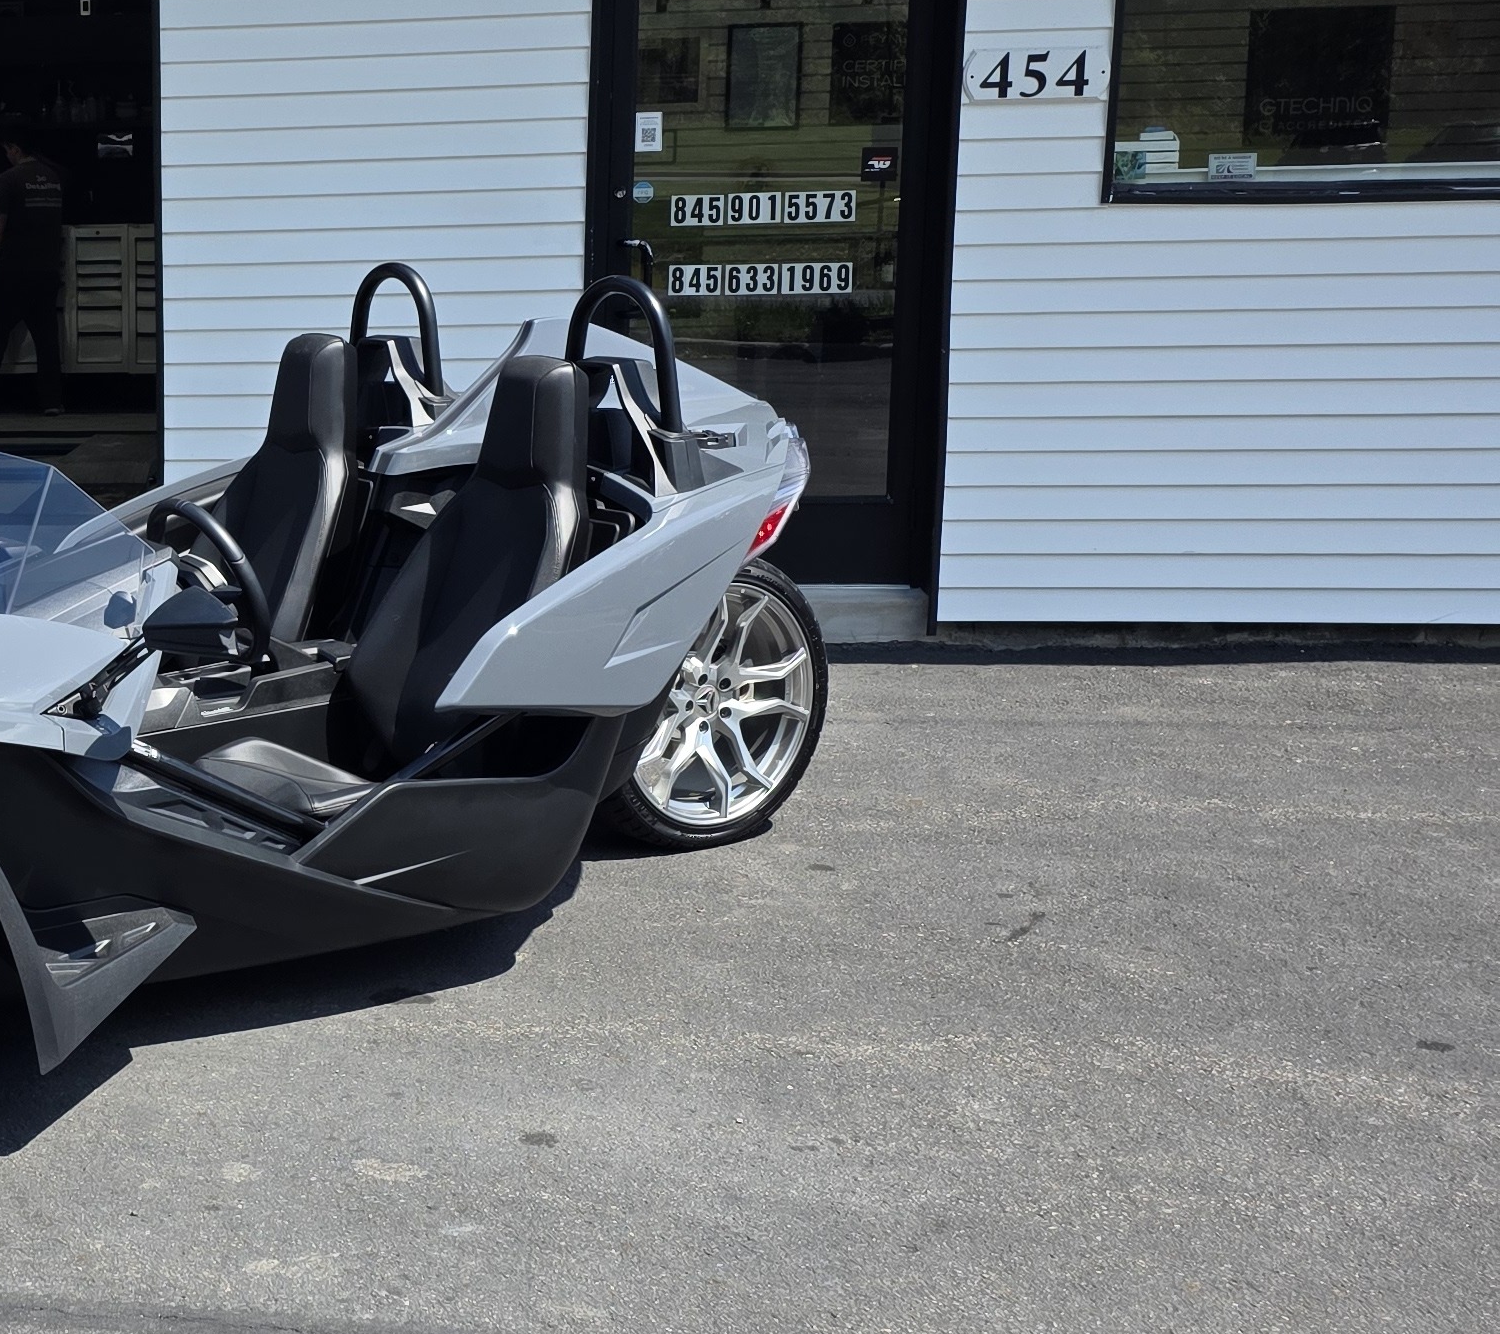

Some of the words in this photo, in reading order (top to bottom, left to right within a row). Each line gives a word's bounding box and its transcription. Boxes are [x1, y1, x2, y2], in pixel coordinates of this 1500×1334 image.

[979, 50, 1089, 98] 454
[1260, 96, 1373, 115] GTECHNIQ
[673, 197, 721, 224] 845
[730, 194, 777, 222] 901
[787, 192, 853, 221] 5573
[671, 267, 719, 293] 845
[728, 265, 775, 293] 633
[786, 264, 850, 292] 1969
